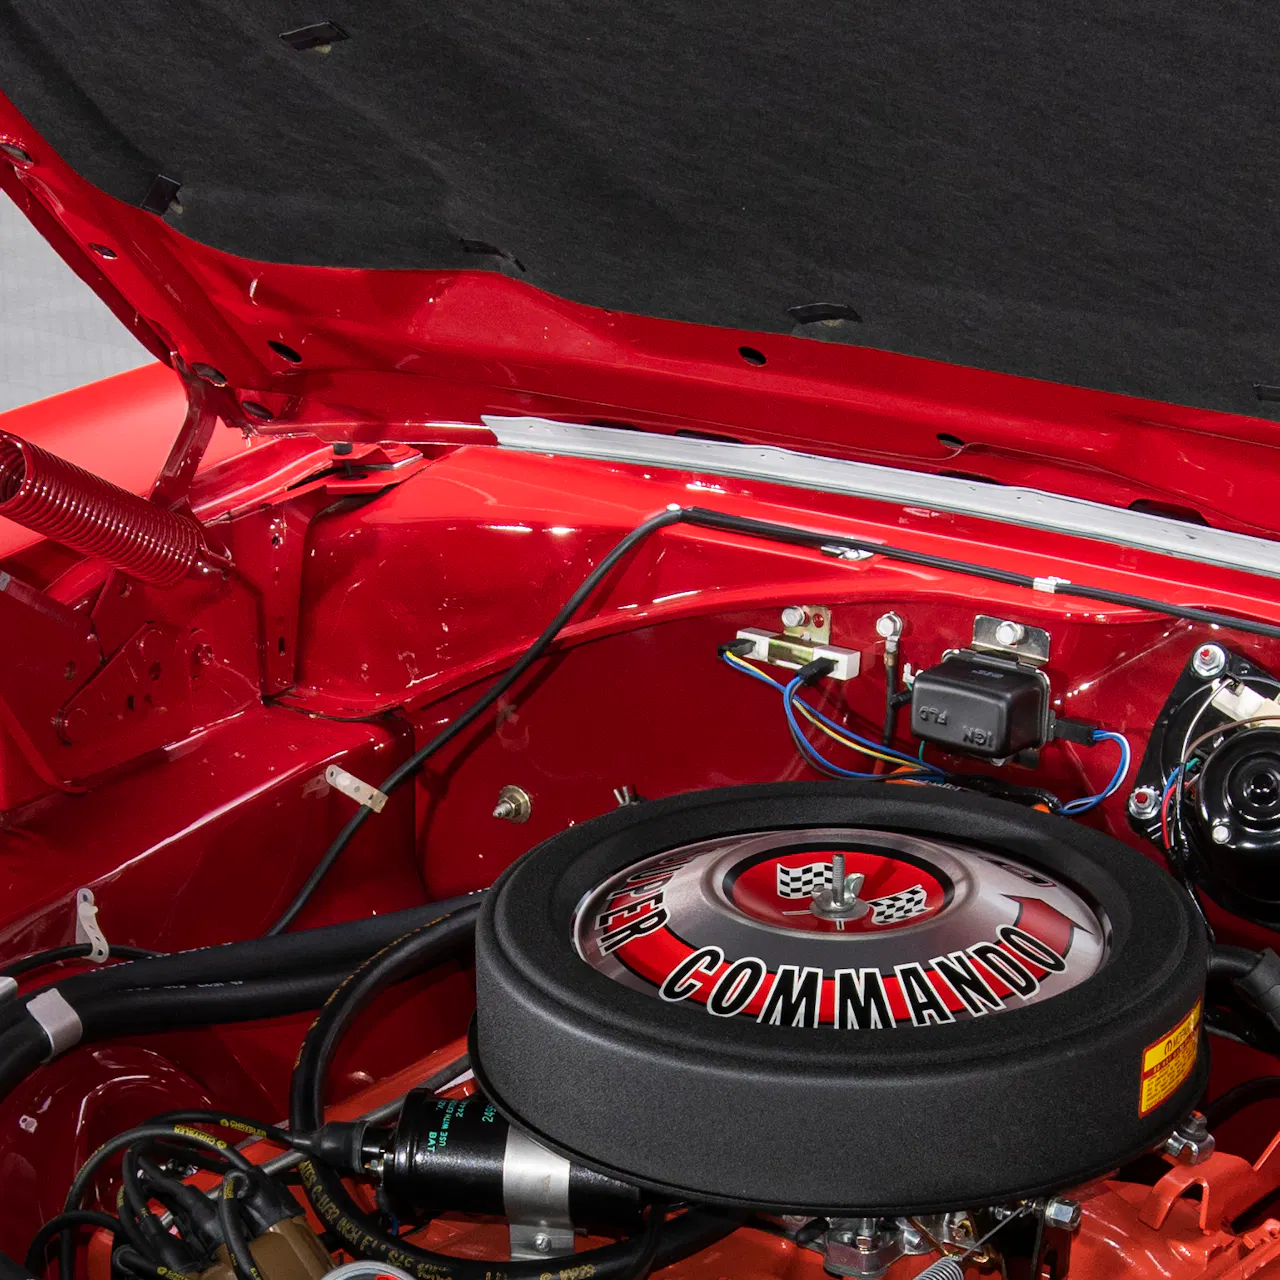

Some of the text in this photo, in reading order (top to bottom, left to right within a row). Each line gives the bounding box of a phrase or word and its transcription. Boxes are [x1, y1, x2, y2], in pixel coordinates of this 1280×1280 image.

[596, 853, 1068, 1029] SUPER COMMANDO
[173, 1126, 217, 1145] CHRYSLER
[229, 1119, 267, 1138] CHRYSLER
[427, 1131, 438, 1152] BAT
[438, 1131, 449, 1147] USE
[336, 1216, 363, 1246] INCH
